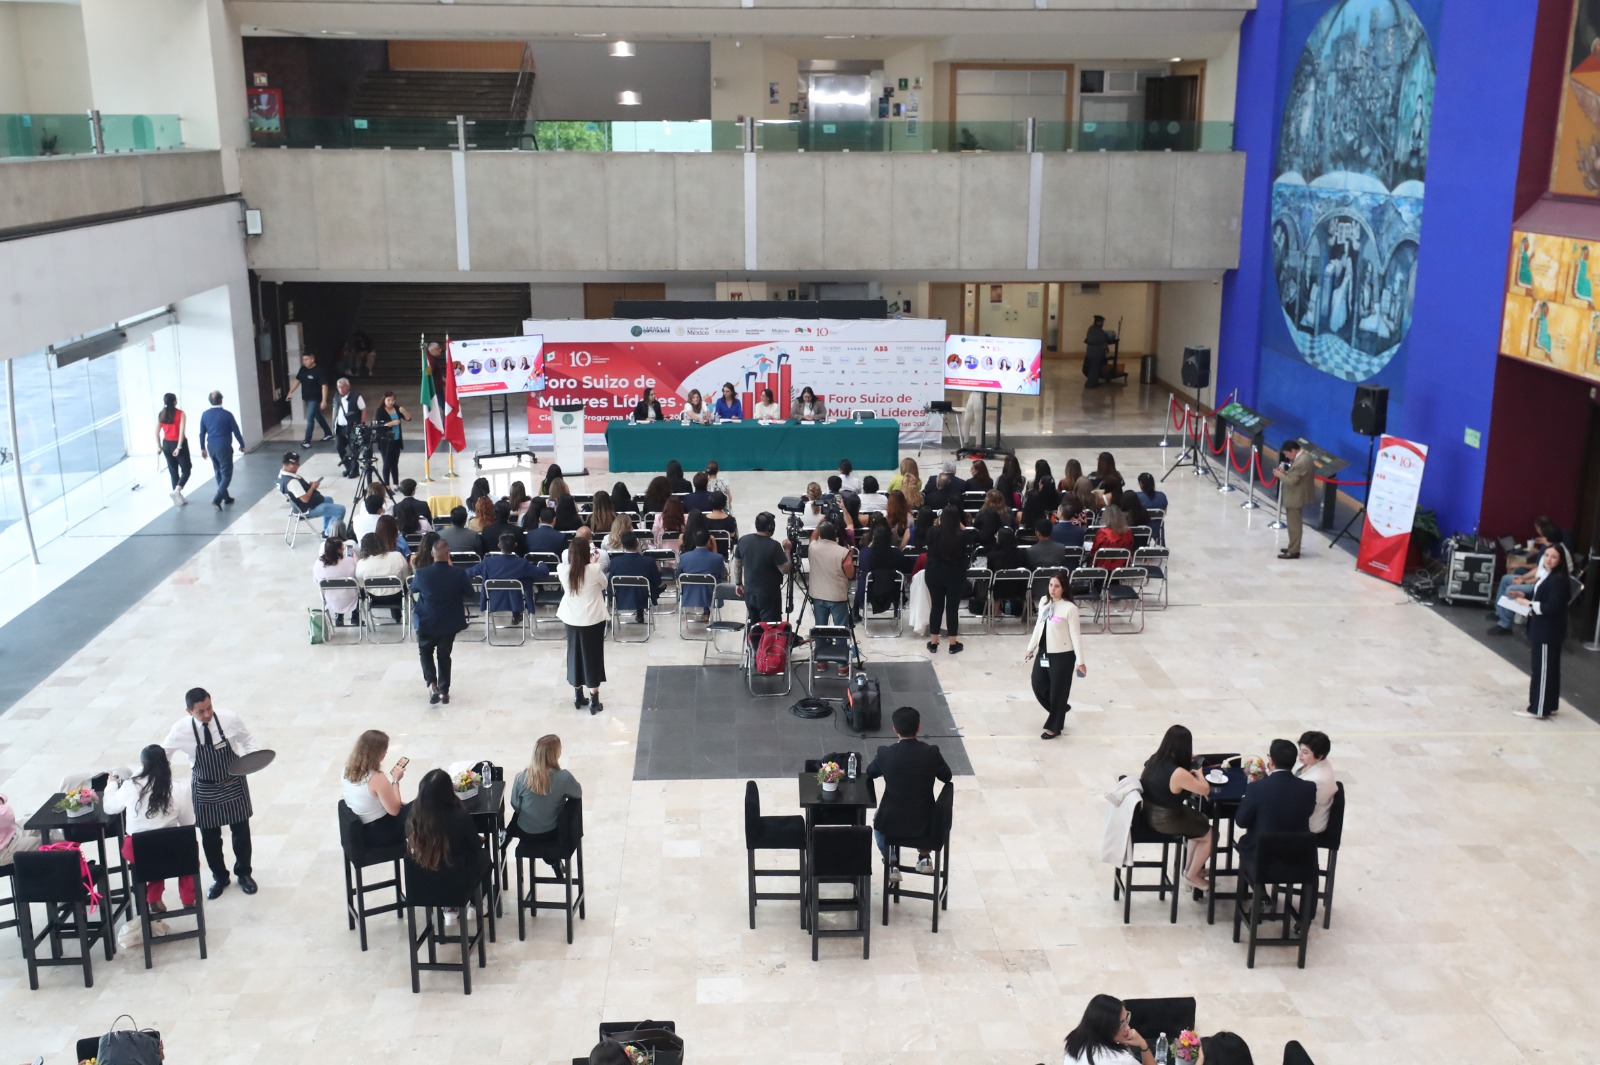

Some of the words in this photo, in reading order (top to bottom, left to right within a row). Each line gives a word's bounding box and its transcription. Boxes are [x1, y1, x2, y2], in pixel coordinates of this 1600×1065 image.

[816, 327, 828, 336] 10
[569, 351, 591, 367] 10
[545, 376, 578, 389] oro
[582, 374, 629, 389] Suizo
[634, 374, 656, 389] de
[613, 394, 676, 408] Lídes
[828, 394, 857, 404] Foro
[860, 393, 893, 404] Suizo
[896, 394, 912, 403] de
[881, 407, 926, 417] Líderes
[583, 414, 623, 422] Programa
